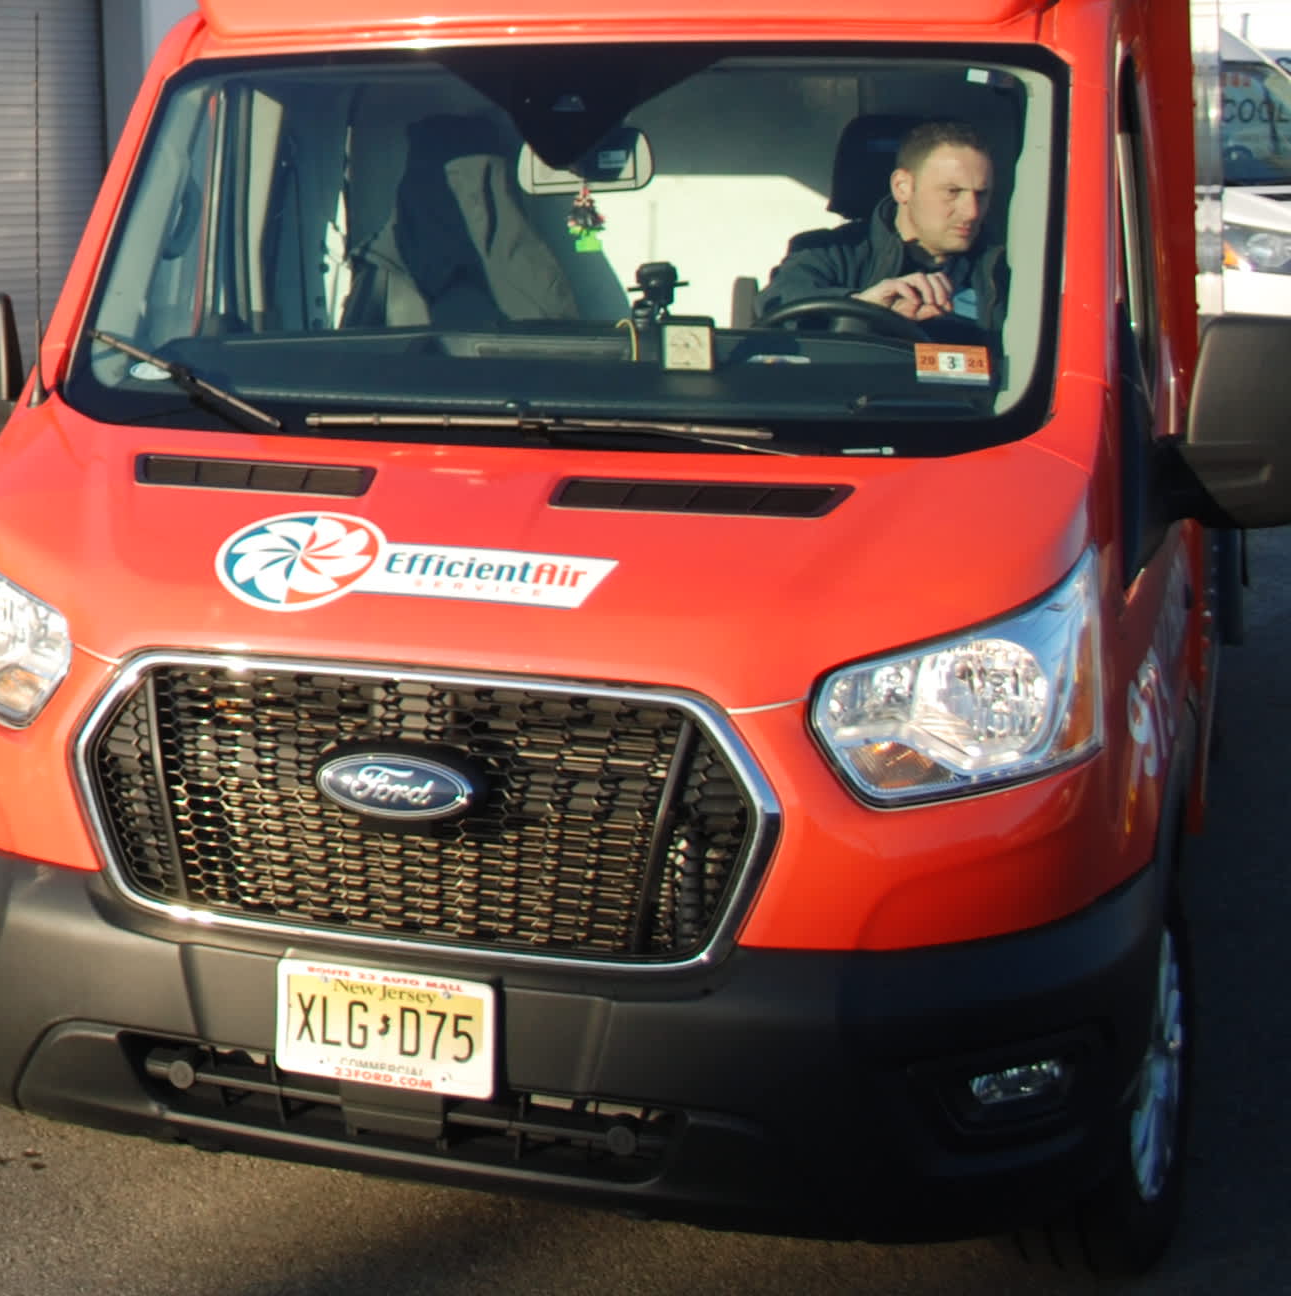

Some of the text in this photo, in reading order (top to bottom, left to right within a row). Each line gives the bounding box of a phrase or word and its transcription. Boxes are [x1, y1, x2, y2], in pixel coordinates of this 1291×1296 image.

[946, 356, 956, 370] 3
[414, 579, 542, 597] SERVICE
[350, 765, 435, 805] Ford
[307, 965, 351, 978] ROUTE
[382, 975, 420, 986] AUTO
[425, 981, 463, 993] MALL
[334, 978, 437, 1005] New Jersey
[296, 993, 474, 1064] XLG D75
[334, 1067, 434, 1090] 23FORD.COM
